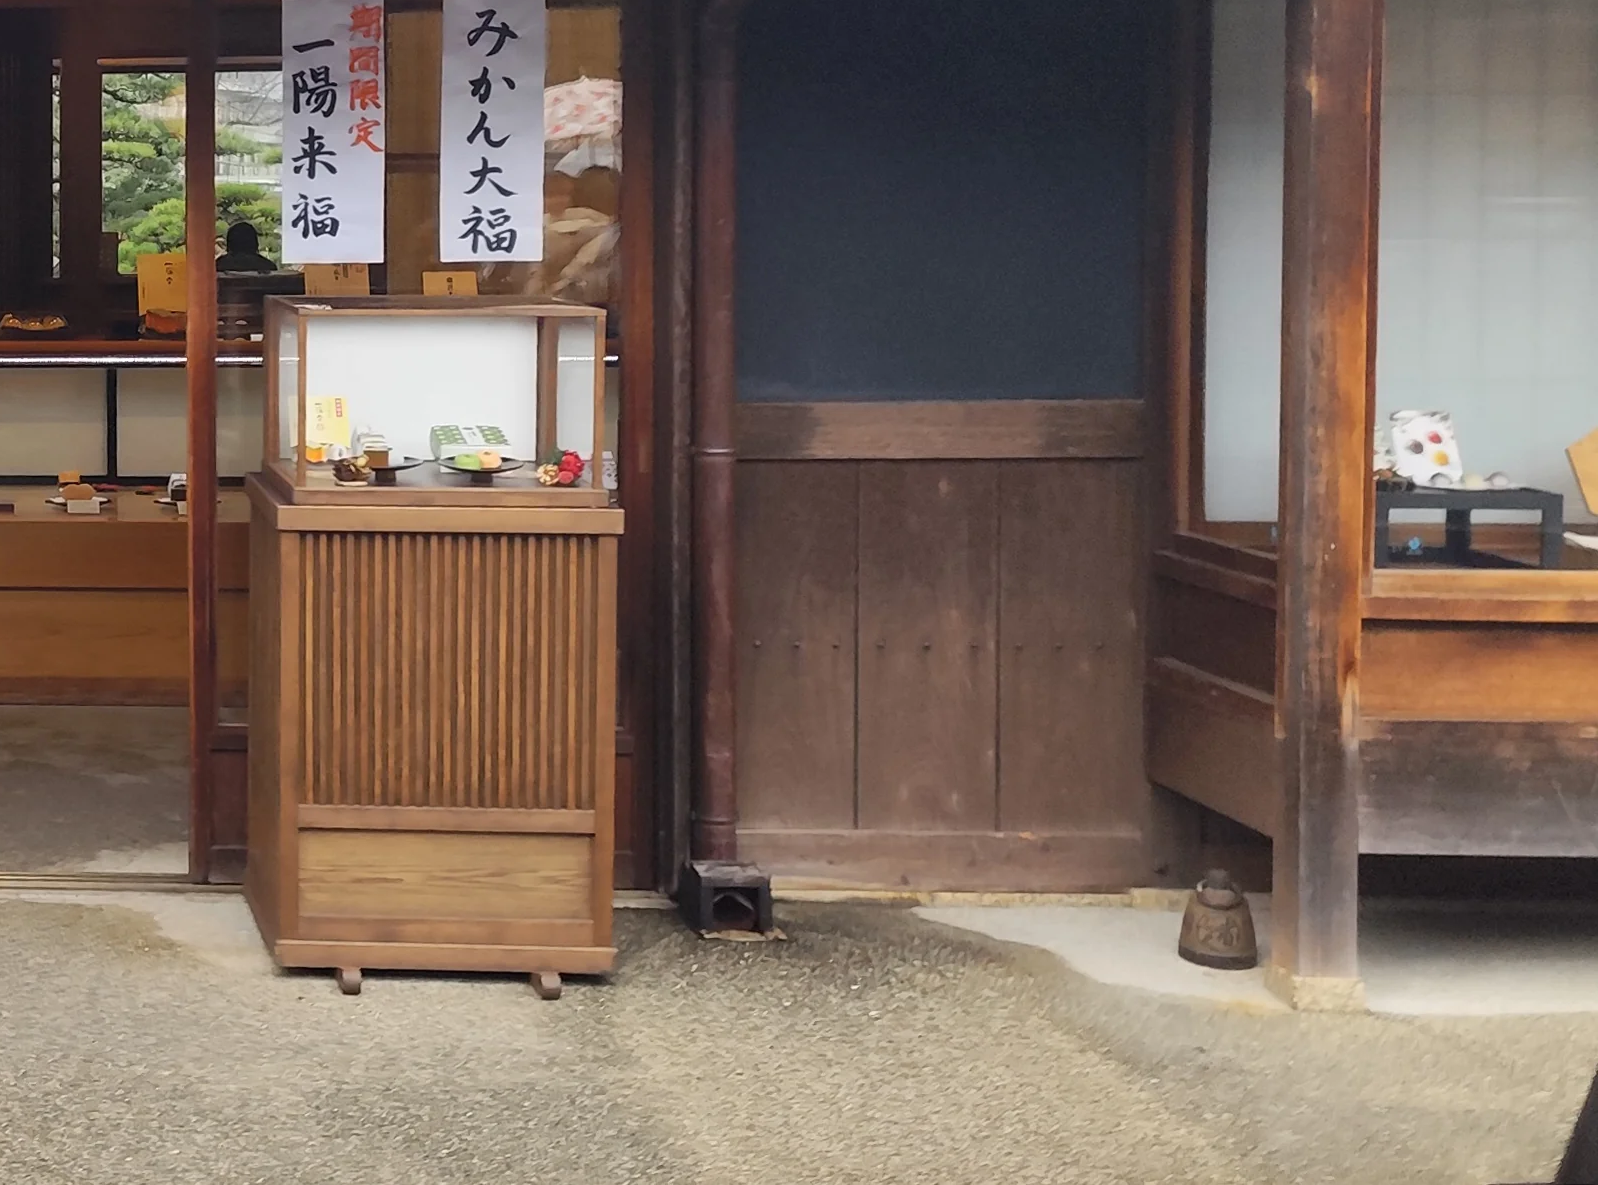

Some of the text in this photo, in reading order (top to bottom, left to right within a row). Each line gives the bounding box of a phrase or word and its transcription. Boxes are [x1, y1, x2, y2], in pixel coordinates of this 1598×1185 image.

[291, 38, 340, 240] 一陽来福
[348, 4, 384, 153] 期間限定
[457, 8, 519, 255] みかん大福
